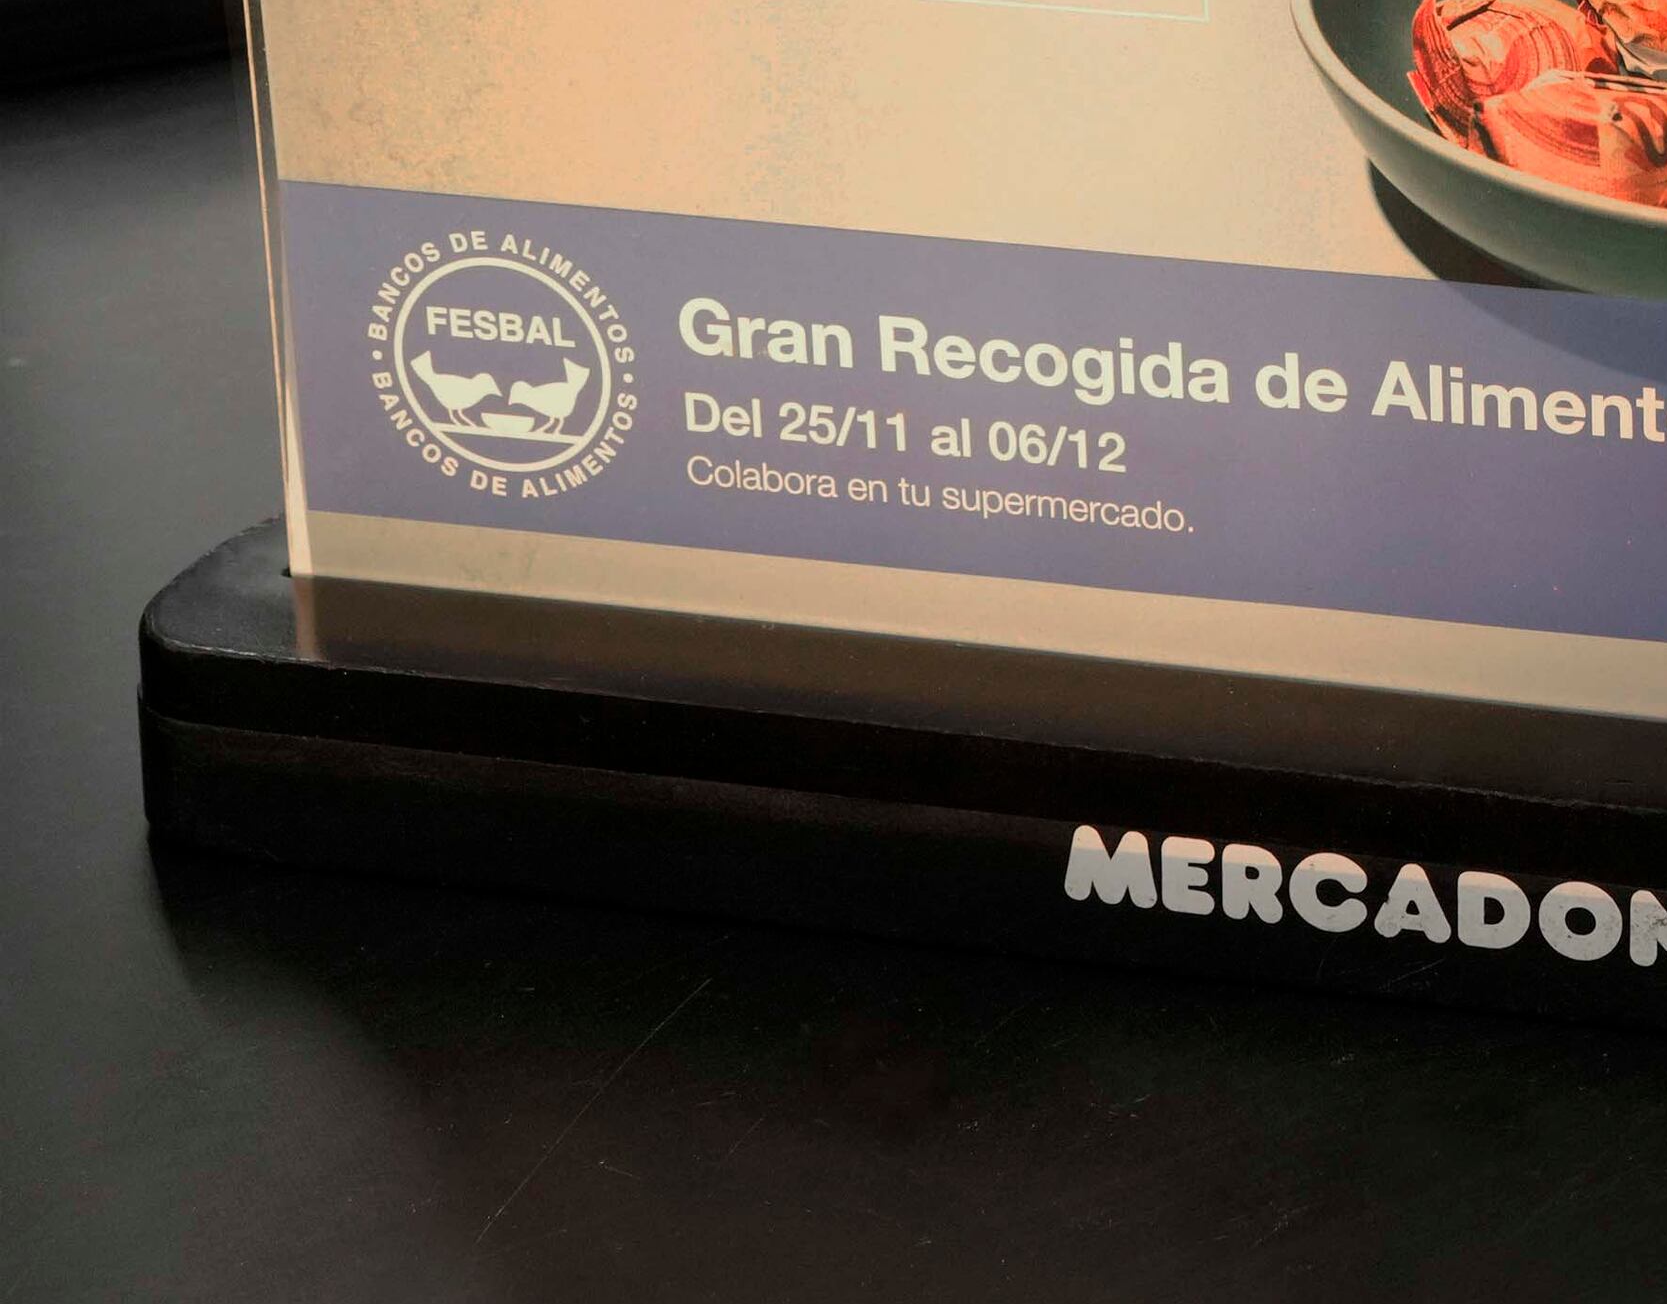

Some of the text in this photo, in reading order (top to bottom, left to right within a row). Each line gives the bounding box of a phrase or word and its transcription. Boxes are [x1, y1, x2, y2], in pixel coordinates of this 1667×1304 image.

[367, 230, 635, 364] BANCOS DE ALIMENTOS
[425, 305, 576, 348] FESBAL
[677, 298, 854, 368] Gran
[879, 315, 1230, 406] Recogida
[1254, 351, 1347, 413] de
[371, 371, 638, 499] BANCOS DE ALIMENTOS
[685, 391, 1127, 474] Del 25/11 al 06/12
[686, 455, 1195, 533] Colabora en tu supermercado.
